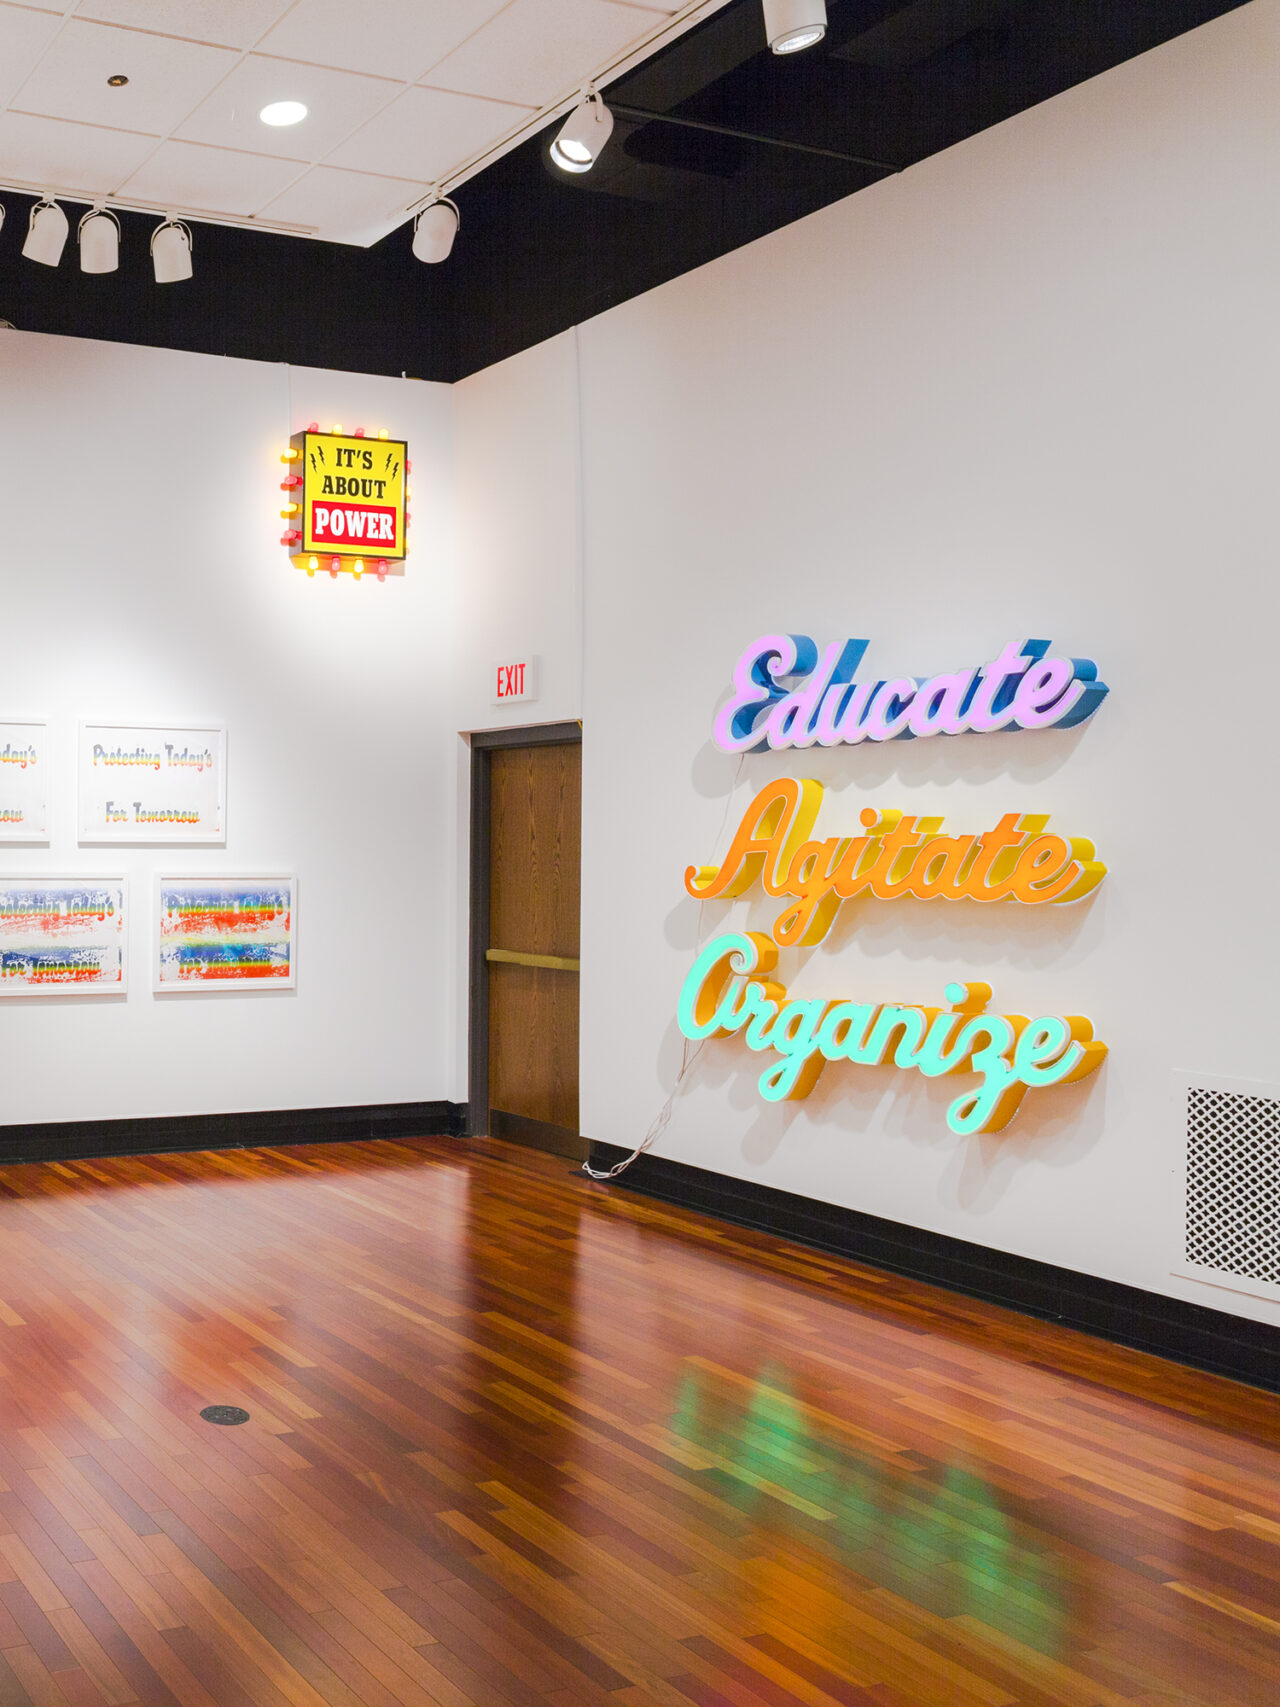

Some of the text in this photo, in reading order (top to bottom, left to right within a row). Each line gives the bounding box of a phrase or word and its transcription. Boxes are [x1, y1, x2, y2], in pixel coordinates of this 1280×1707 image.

[335, 448, 373, 470] IT'S
[321, 475, 386, 499] ABOUT
[315, 507, 394, 540] POWER
[497, 663, 526, 697] EXIT
[711, 633, 1096, 755] Educate
[93, 744, 213, 772] Protecting Today's
[105, 801, 200, 824] For Tomorrow
[684, 778, 1096, 947] Agitate
[677, 932, 1096, 1134] Organize
